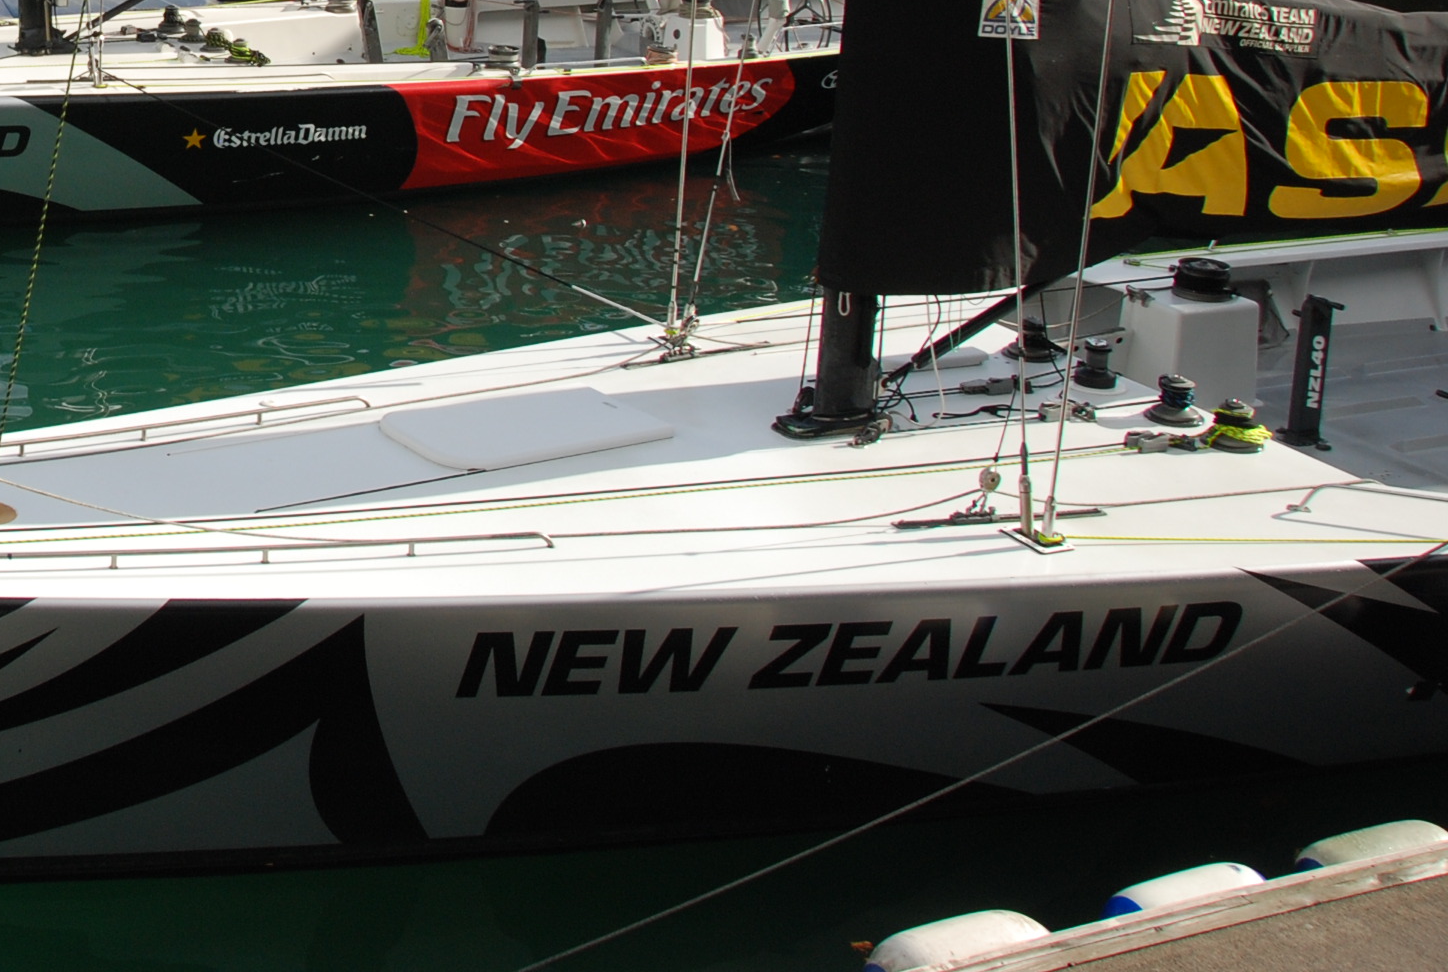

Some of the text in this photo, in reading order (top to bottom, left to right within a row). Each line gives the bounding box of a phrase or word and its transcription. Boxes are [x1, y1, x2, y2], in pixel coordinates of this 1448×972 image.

[1271, 6, 1317, 25] TEAM
[981, 24, 1035, 36] DOYLE
[1202, 17, 1314, 44] NEW ZEALAND
[1239, 39, 1274, 51] OFFICIAL
[447, 75, 773, 149] Fly Emirates
[212, 123, 367, 149] Estrella Damm
[455, 600, 1244, 699] NEW ZEALAND
